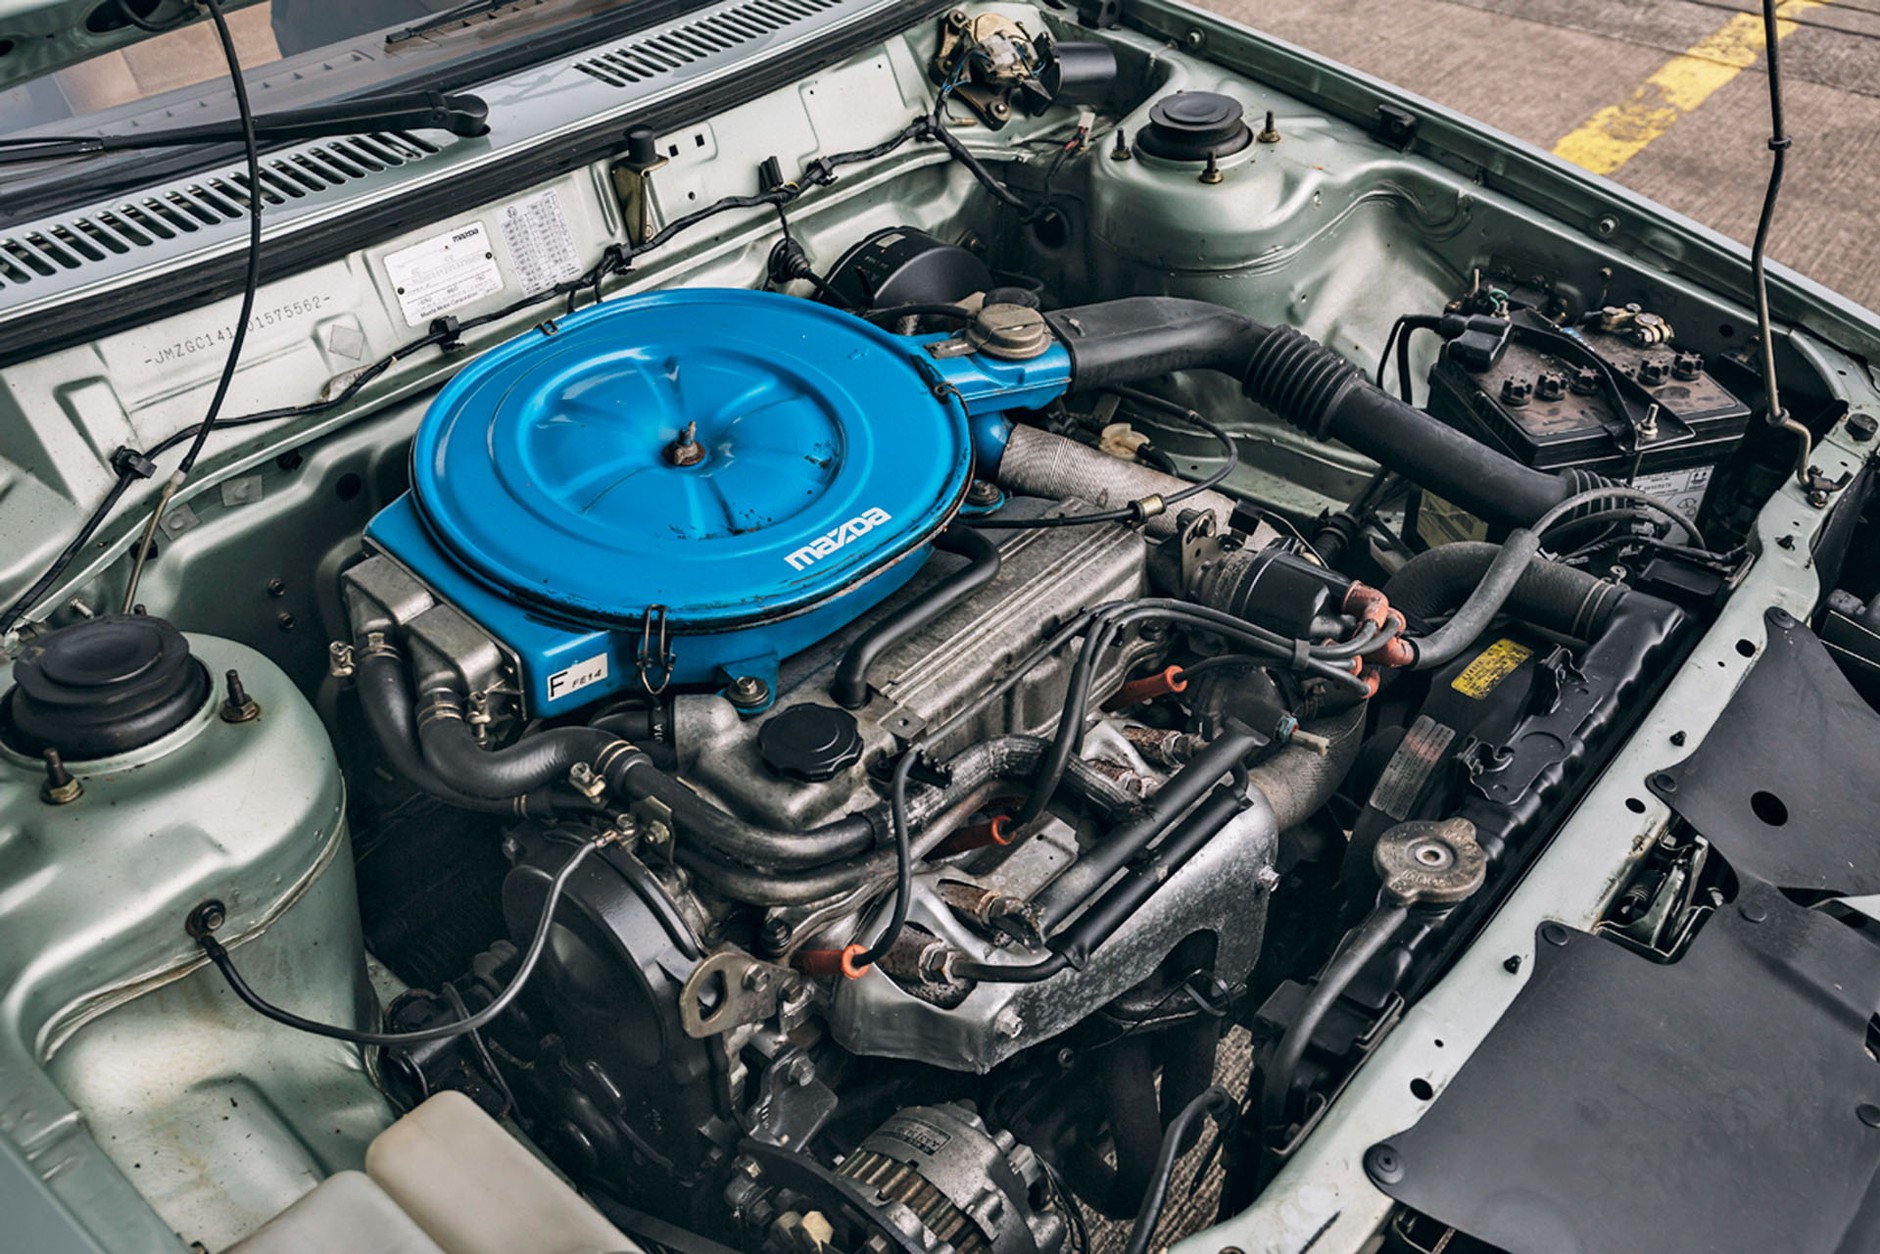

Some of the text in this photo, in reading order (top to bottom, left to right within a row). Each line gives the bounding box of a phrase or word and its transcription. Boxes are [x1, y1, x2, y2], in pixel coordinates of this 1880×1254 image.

[144, 295, 331, 365] -JMZGC14101575562-
[550, 668, 602, 697] F FE14
